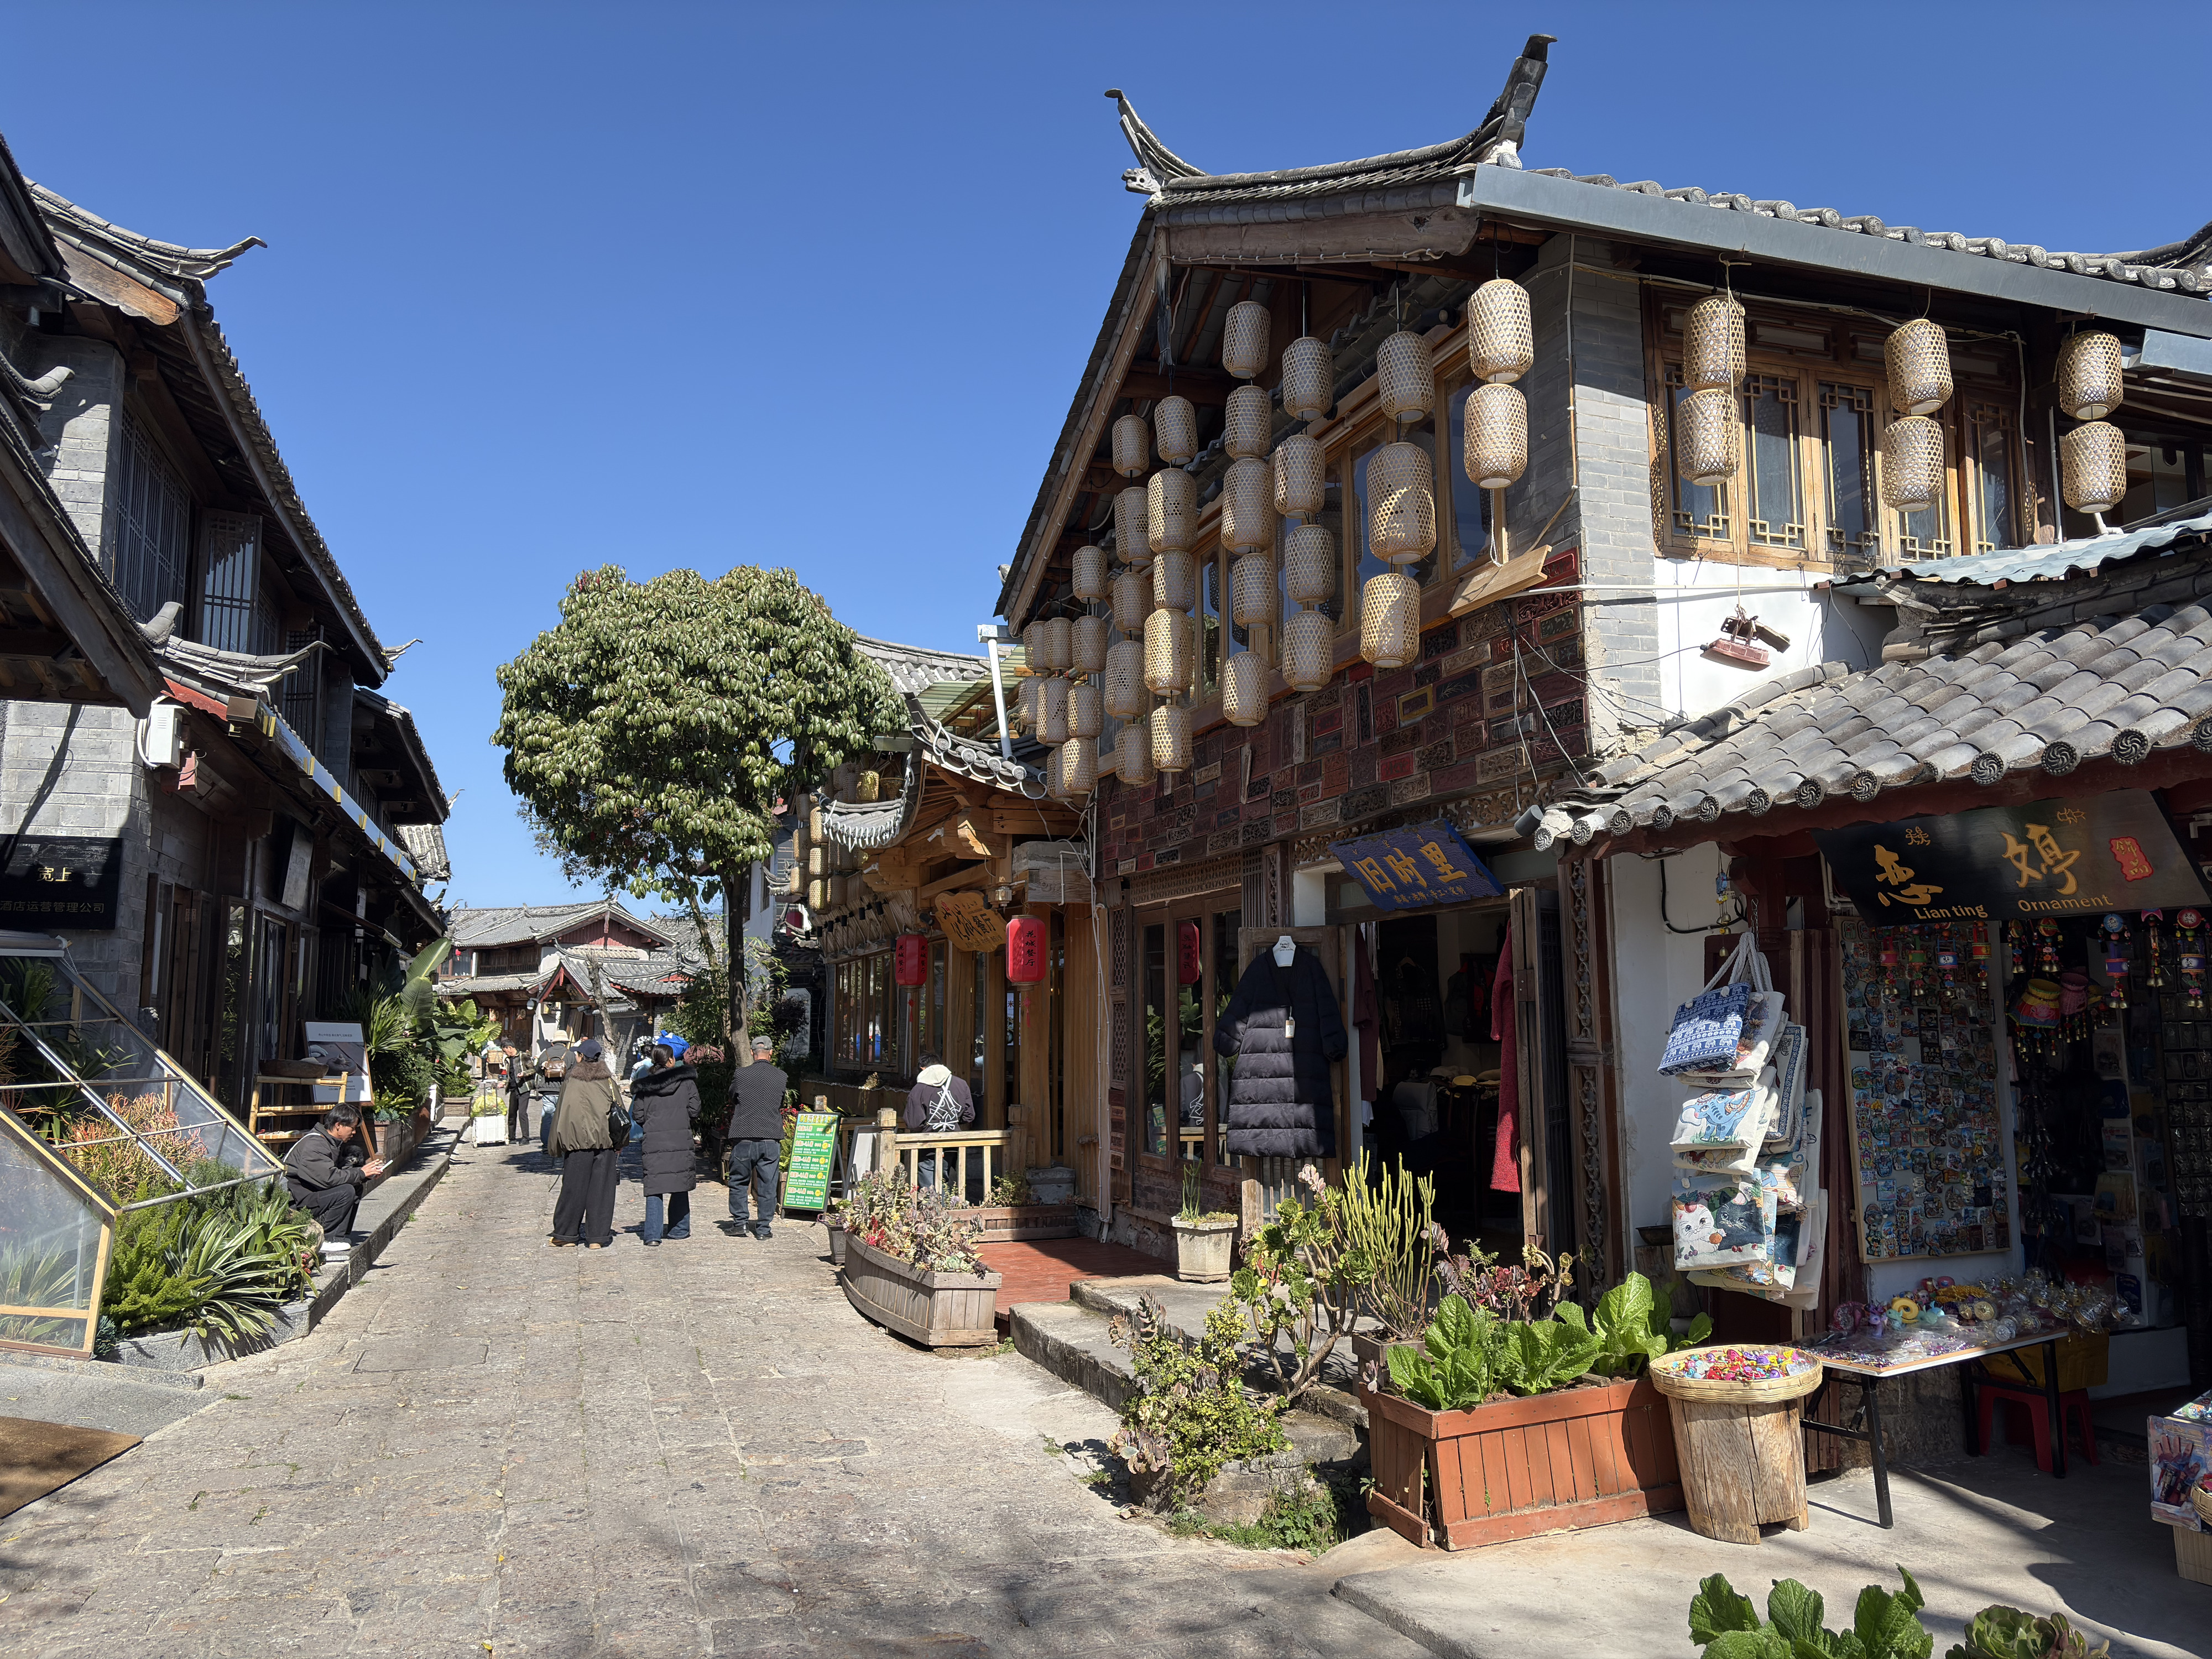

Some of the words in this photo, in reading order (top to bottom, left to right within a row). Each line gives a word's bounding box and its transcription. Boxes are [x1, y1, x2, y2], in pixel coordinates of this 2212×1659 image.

[36, 866, 74, 882] 宽上
[1352, 841, 1468, 894] 旧时里
[2018, 894, 2114, 912] Ornament
[1914, 907, 1951, 920] Lian
[1952, 905, 1988, 919] ting
[1025, 930, 1037, 967] 花城餐厅
